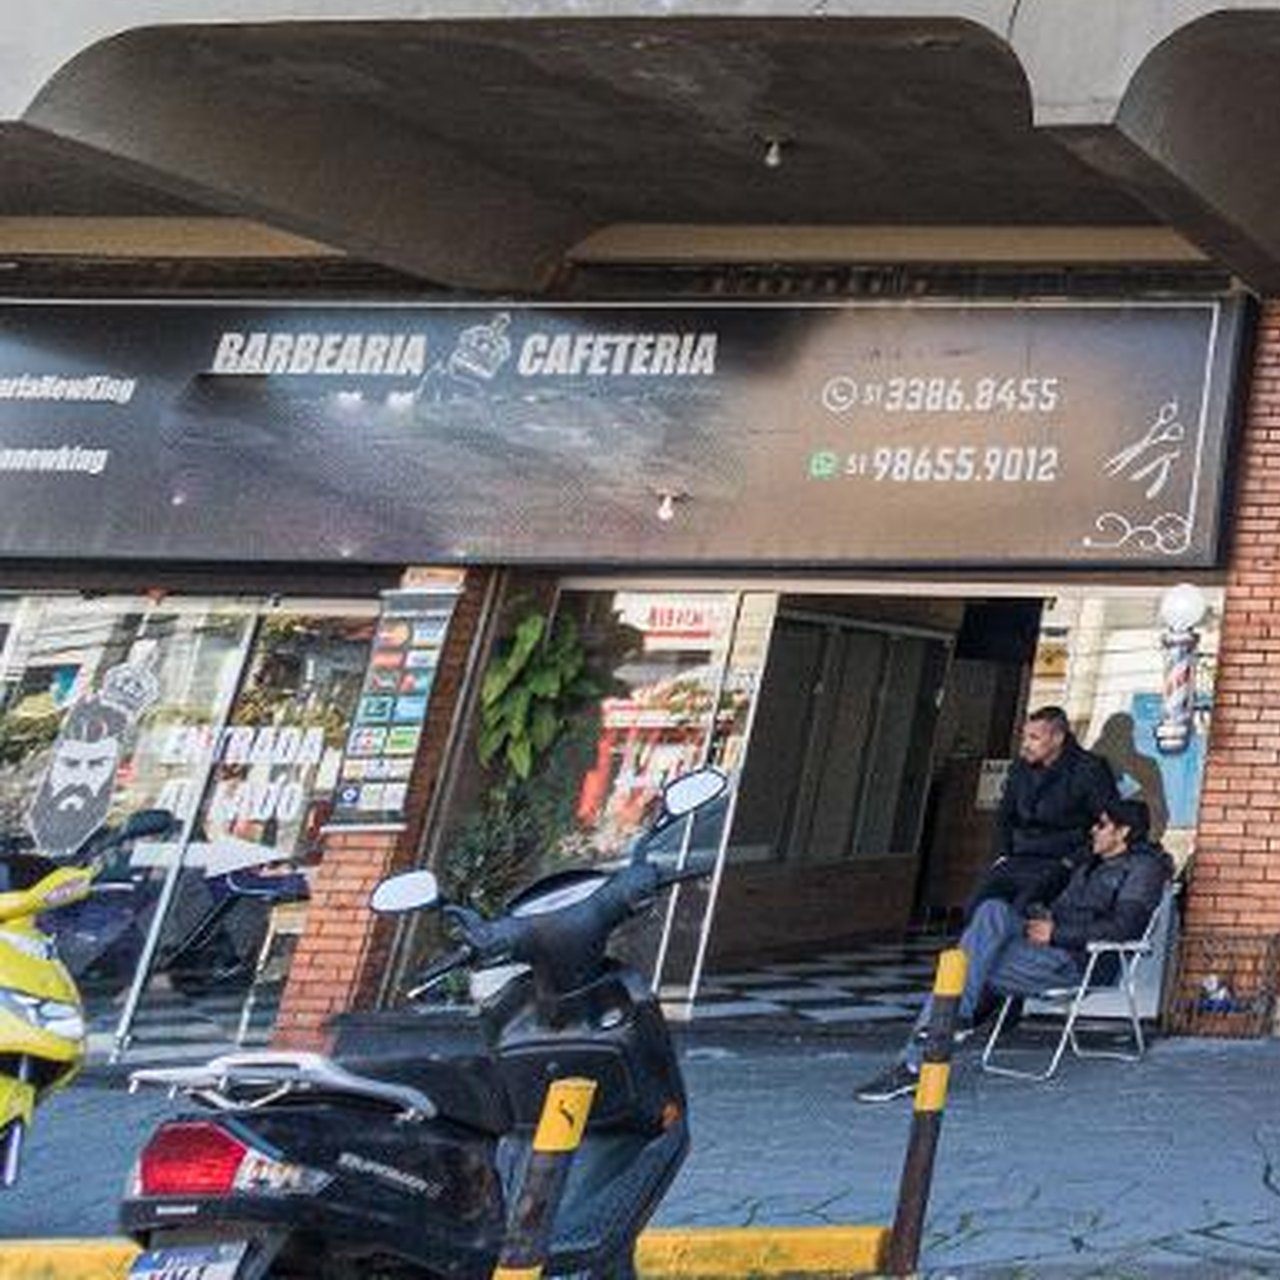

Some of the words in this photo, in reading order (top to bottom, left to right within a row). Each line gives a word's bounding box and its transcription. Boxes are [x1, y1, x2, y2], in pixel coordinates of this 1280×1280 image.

[212, 332, 428, 375] BARBEARIA
[516, 332, 719, 375] CAFETERIA
[885, 376, 1059, 411] 3386.8455
[871, 445, 1058, 481] 98655.9012
